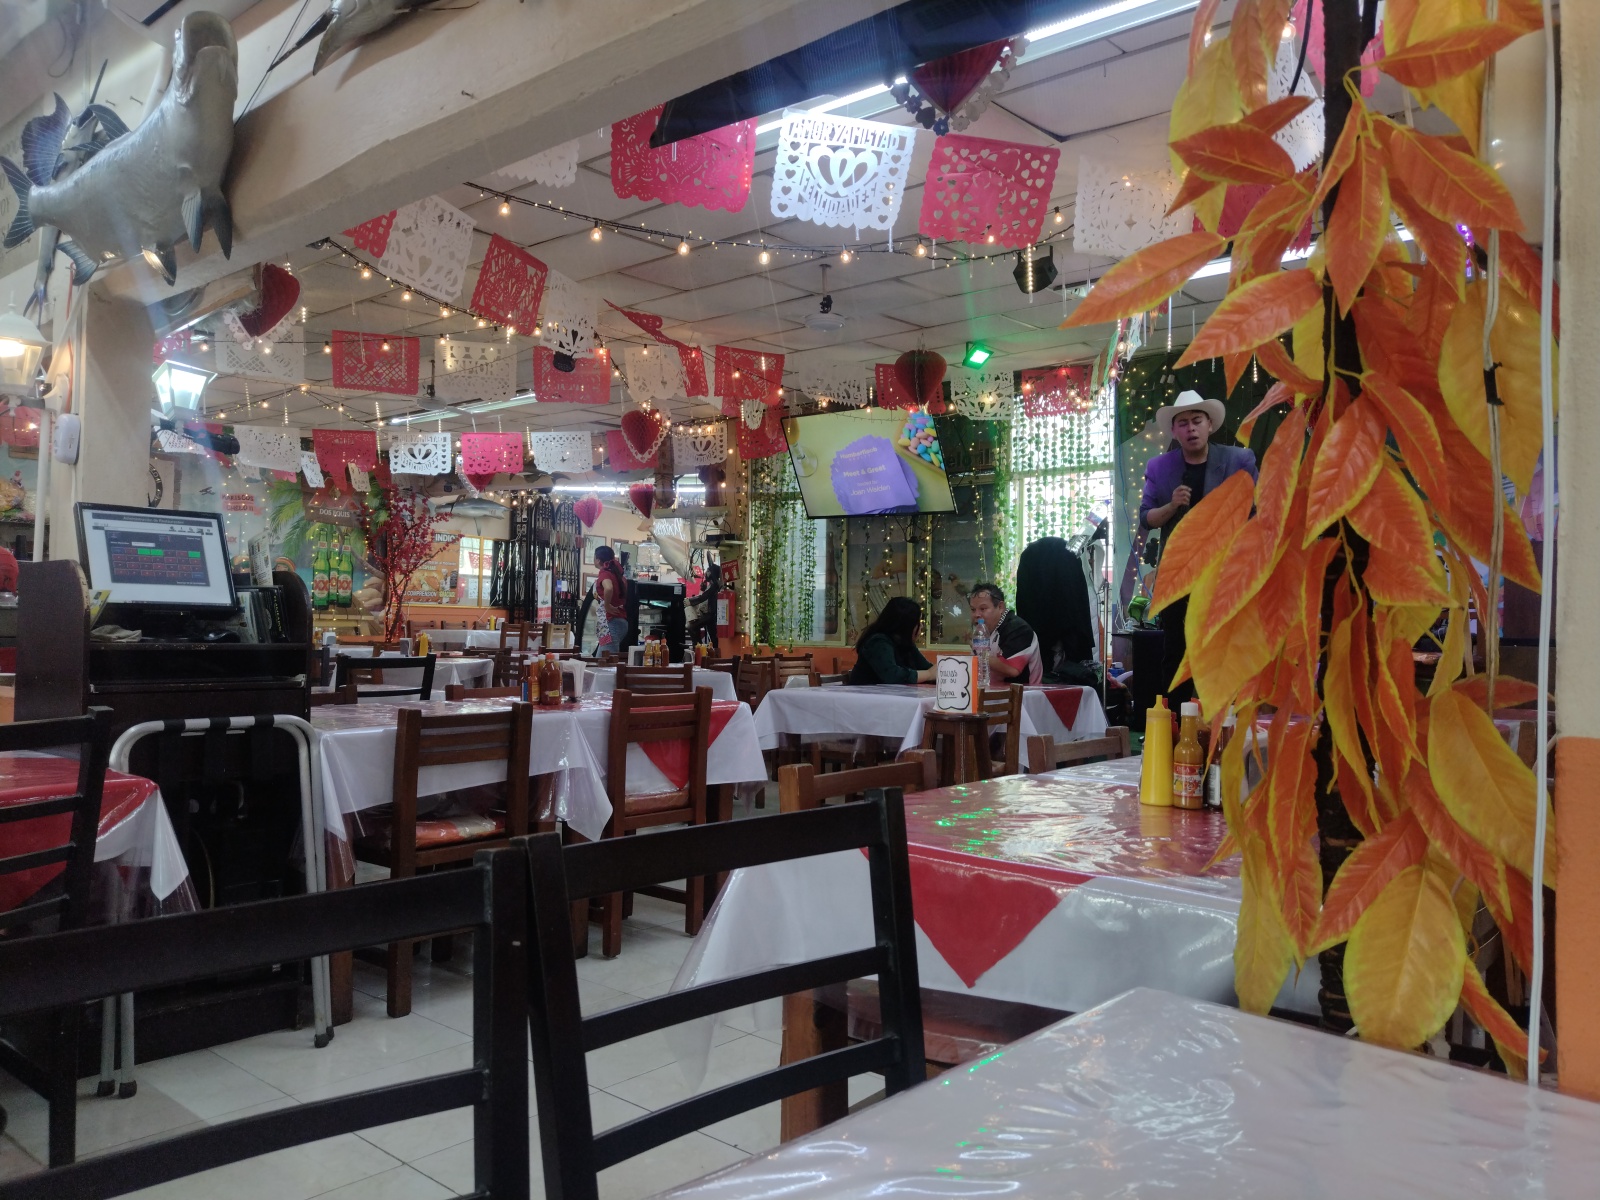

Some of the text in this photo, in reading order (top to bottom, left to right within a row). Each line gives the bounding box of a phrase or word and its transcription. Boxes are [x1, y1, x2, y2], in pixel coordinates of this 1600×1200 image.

[799, 169, 877, 215] FELICIDADES
[843, 470, 860, 478] Meet
[866, 464, 887, 474] Greet
[319, 508, 331, 516] DOS
